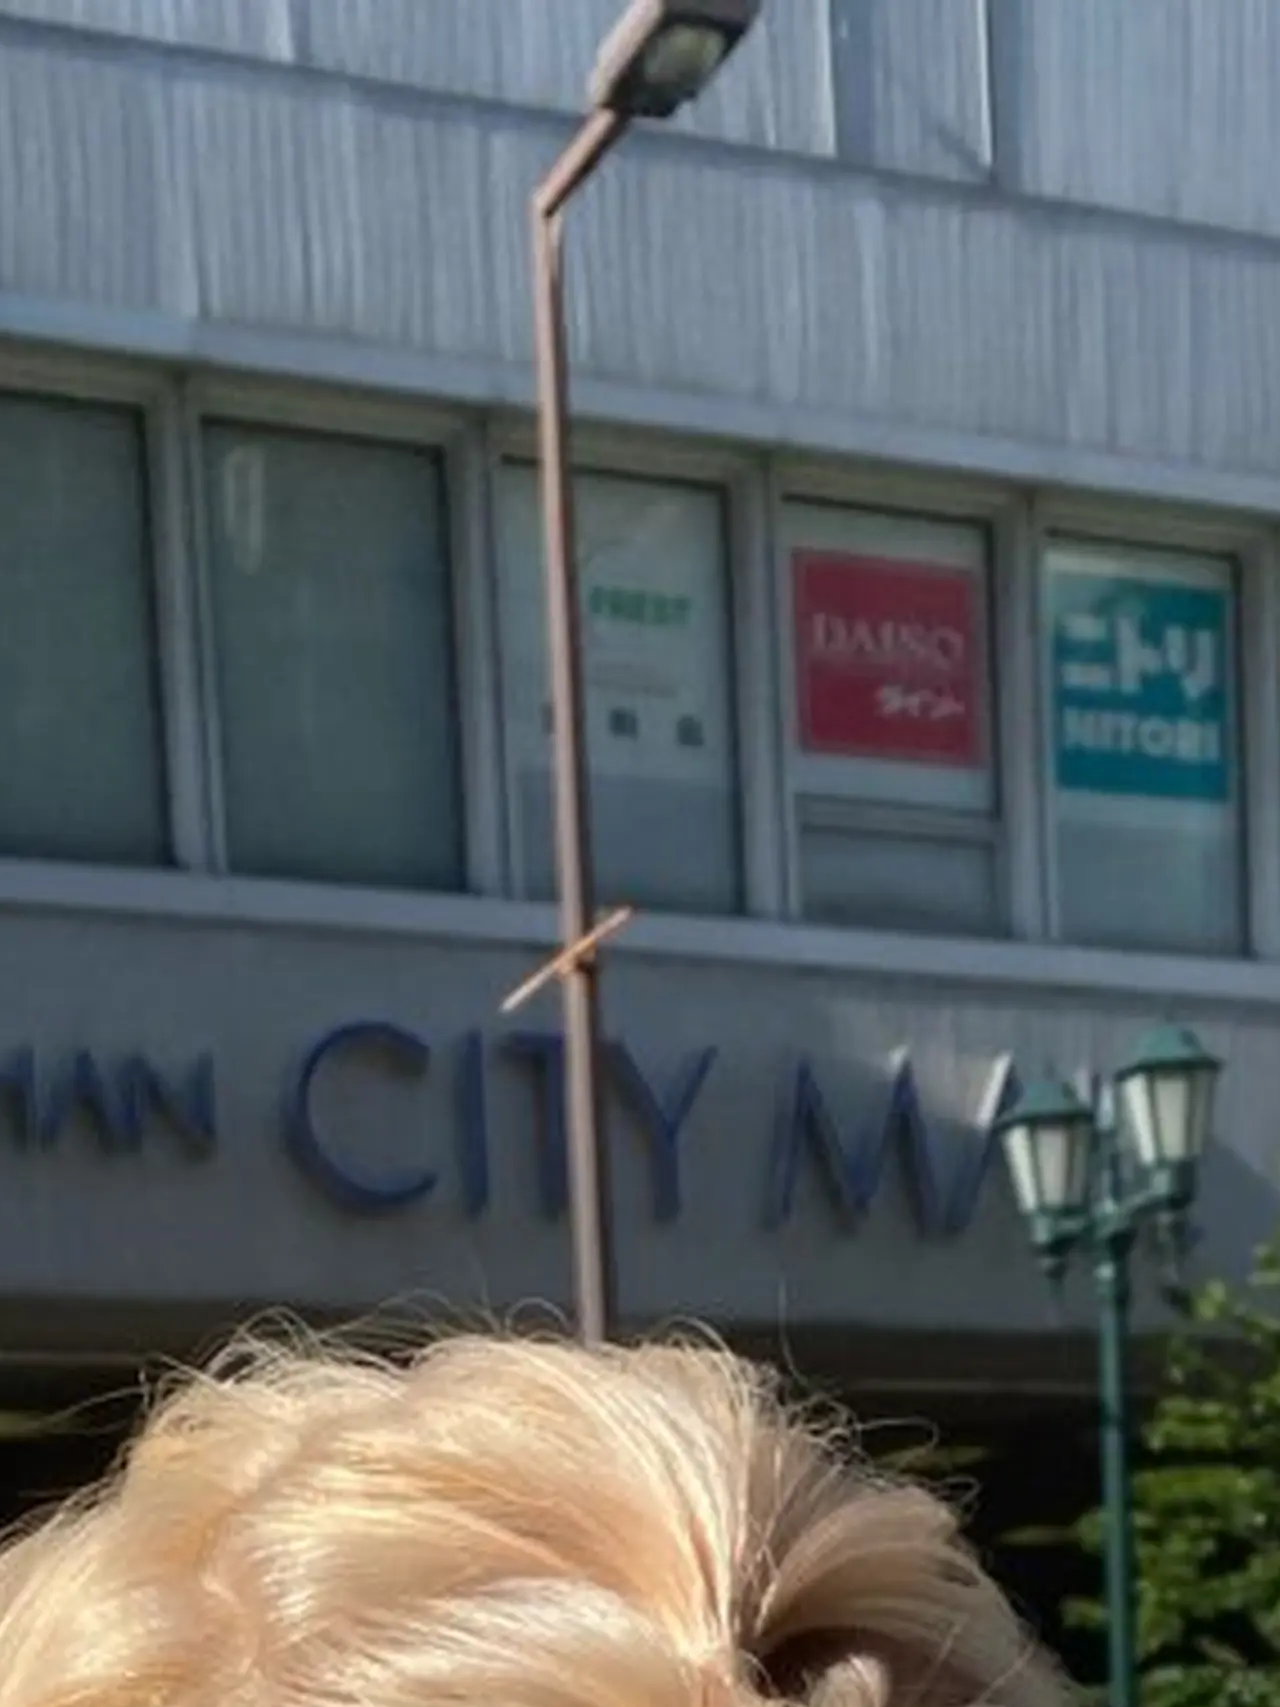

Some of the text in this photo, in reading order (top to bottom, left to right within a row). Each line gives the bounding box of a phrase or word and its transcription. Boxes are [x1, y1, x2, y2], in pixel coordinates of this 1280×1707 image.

[812, 611, 966, 671] DAISO
[1061, 604, 1216, 703] ニトリ
[1062, 706, 1220, 764] NITORI
[280, 1018, 717, 1224] CITY
